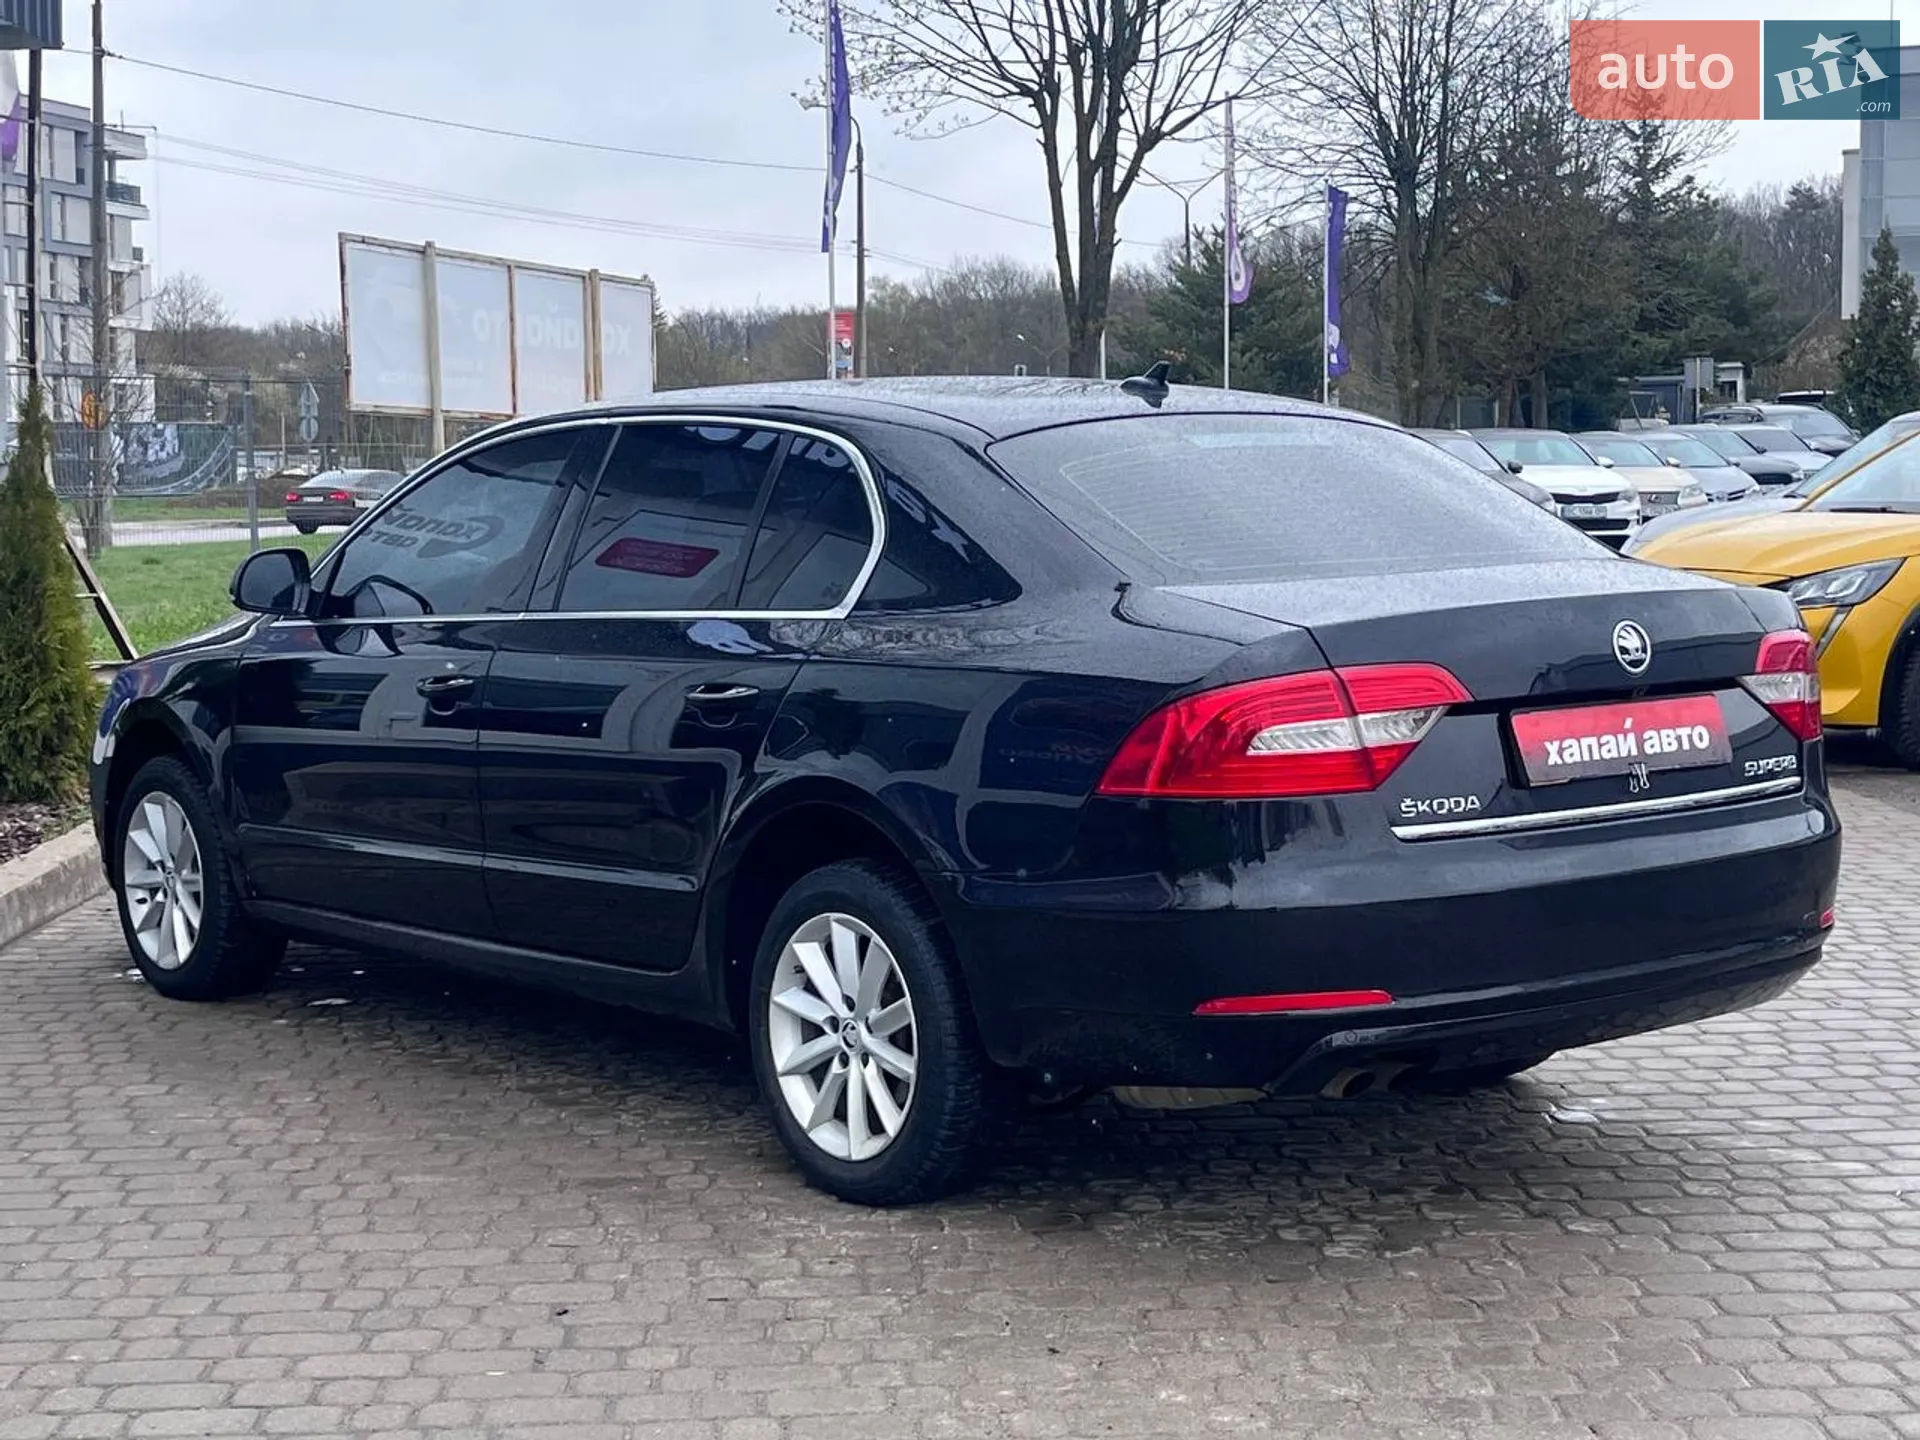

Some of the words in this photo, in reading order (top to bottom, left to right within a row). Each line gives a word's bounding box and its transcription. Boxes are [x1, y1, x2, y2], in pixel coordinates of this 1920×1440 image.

[1643, 725, 1710, 755] авто
[1744, 754, 1797, 777] SUPERB
[1400, 794, 1482, 818] ŠKODA
